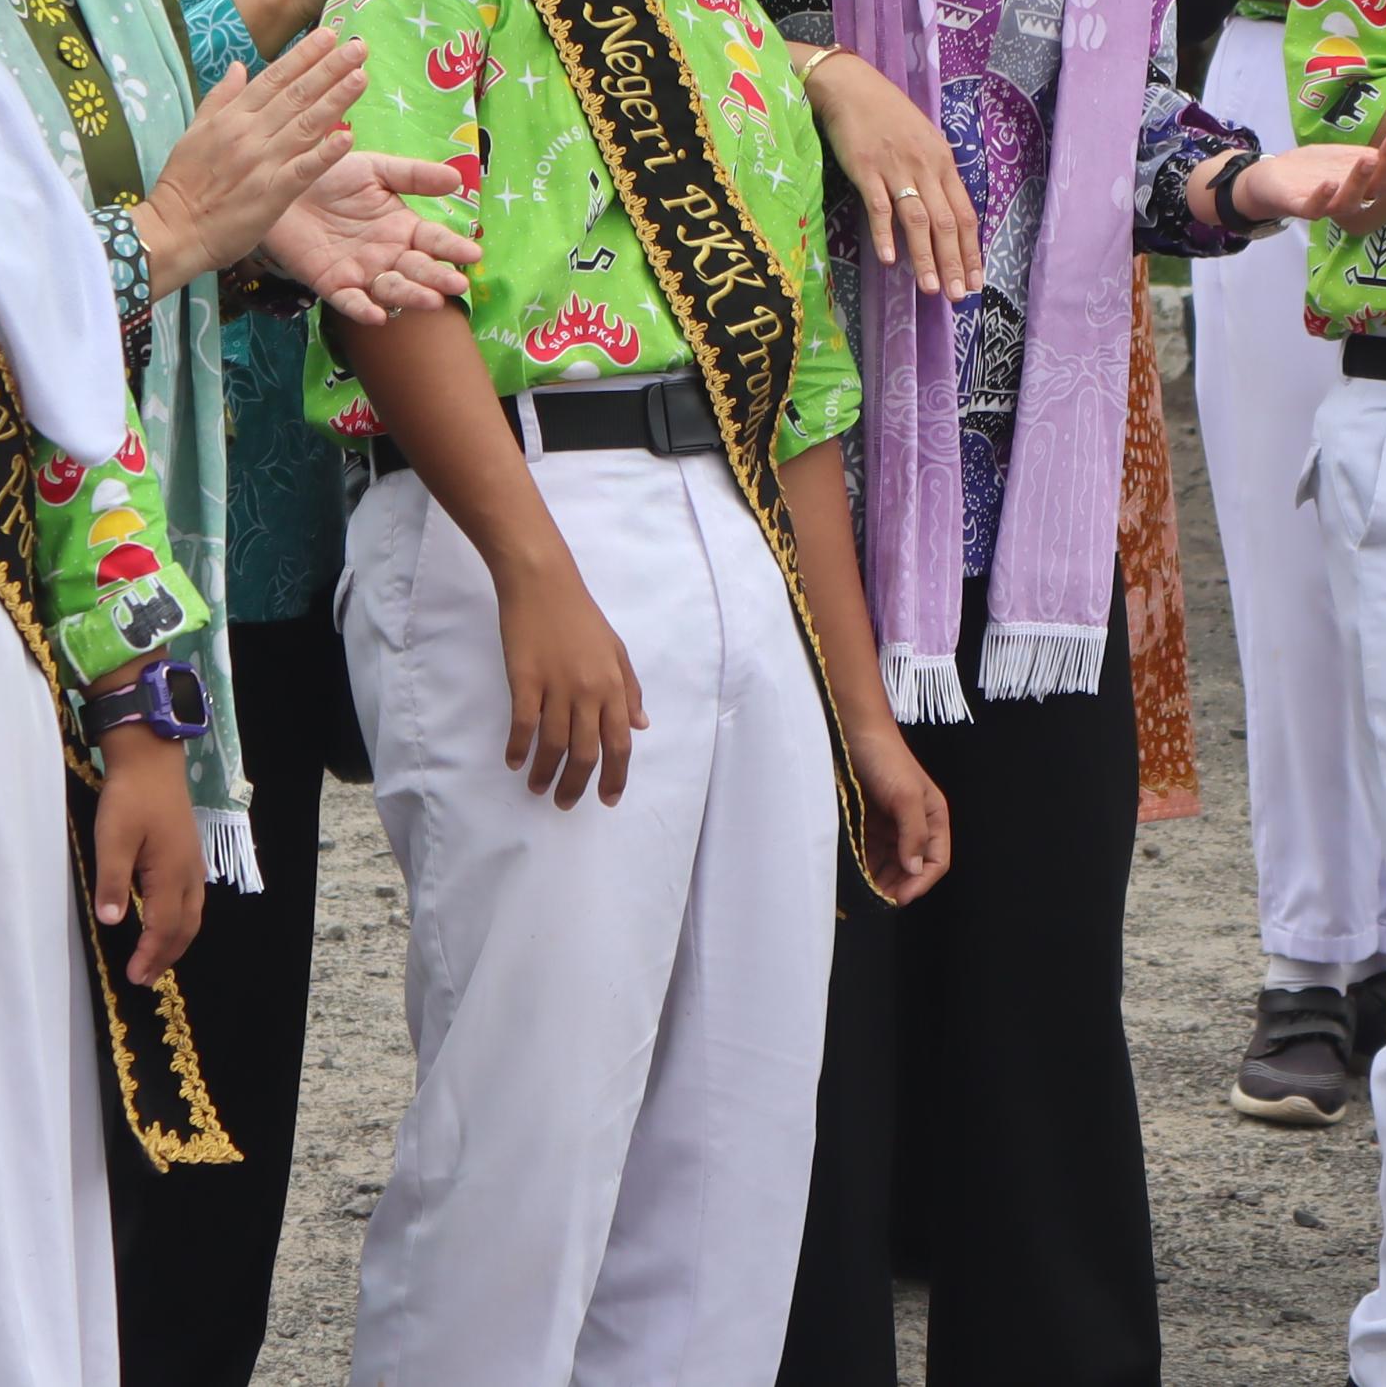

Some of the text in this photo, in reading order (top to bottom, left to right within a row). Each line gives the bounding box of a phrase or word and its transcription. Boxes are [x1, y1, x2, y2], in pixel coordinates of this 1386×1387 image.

[582, 1, 686, 174] Negeri
[661, 183, 766, 318] PKK
[549, 324, 616, 351] SLB N PKK
[65, 459, 80, 478] SL
